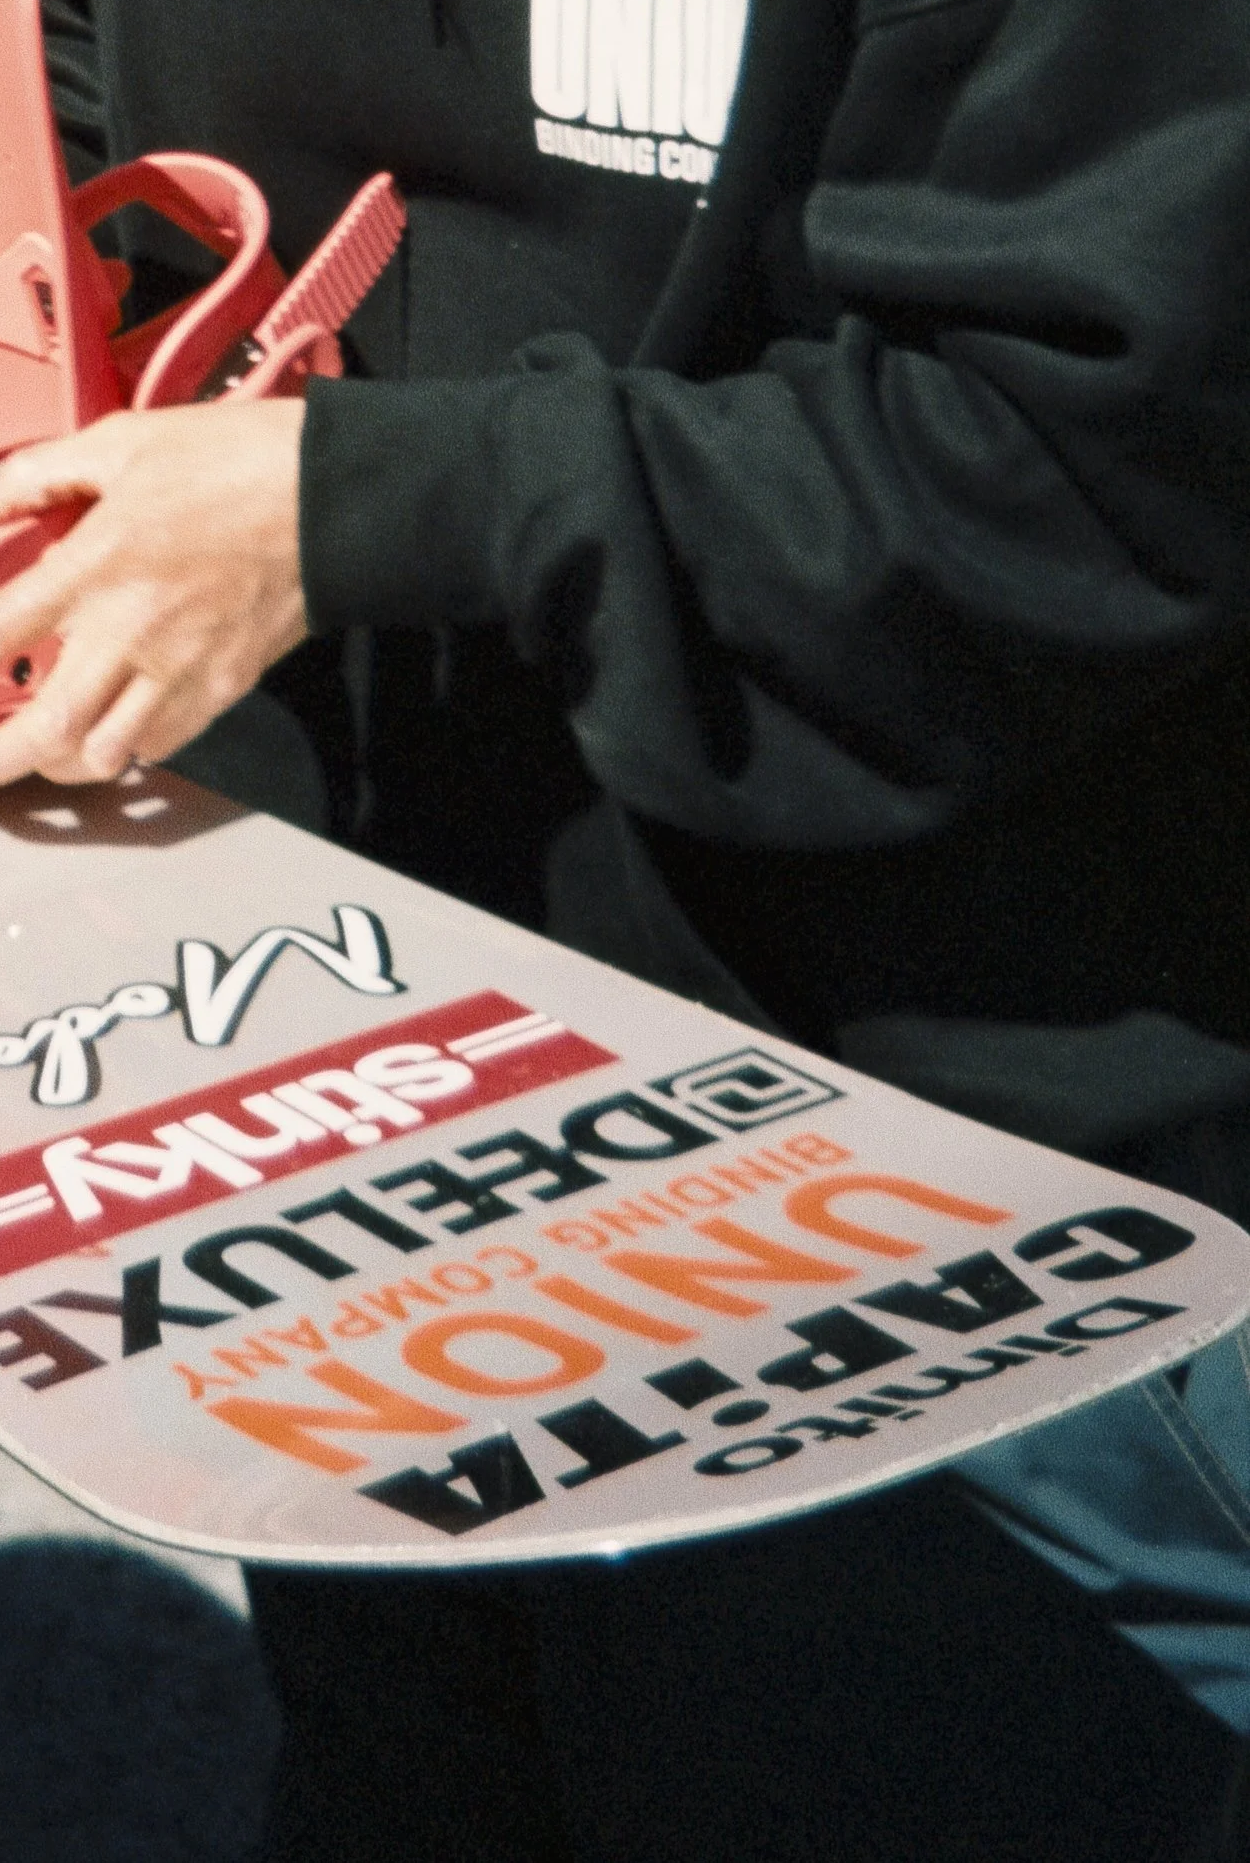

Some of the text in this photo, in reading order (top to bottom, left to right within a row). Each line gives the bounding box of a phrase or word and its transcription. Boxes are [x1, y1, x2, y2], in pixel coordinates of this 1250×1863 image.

[534, 118, 656, 176] BINDING
[41, 1042, 475, 1223] stinky
[171, 1131, 854, 1402] BINDING COMPANY
[203, 1171, 1016, 1475] UNION
[693, 1295, 1189, 1476] Dimito
